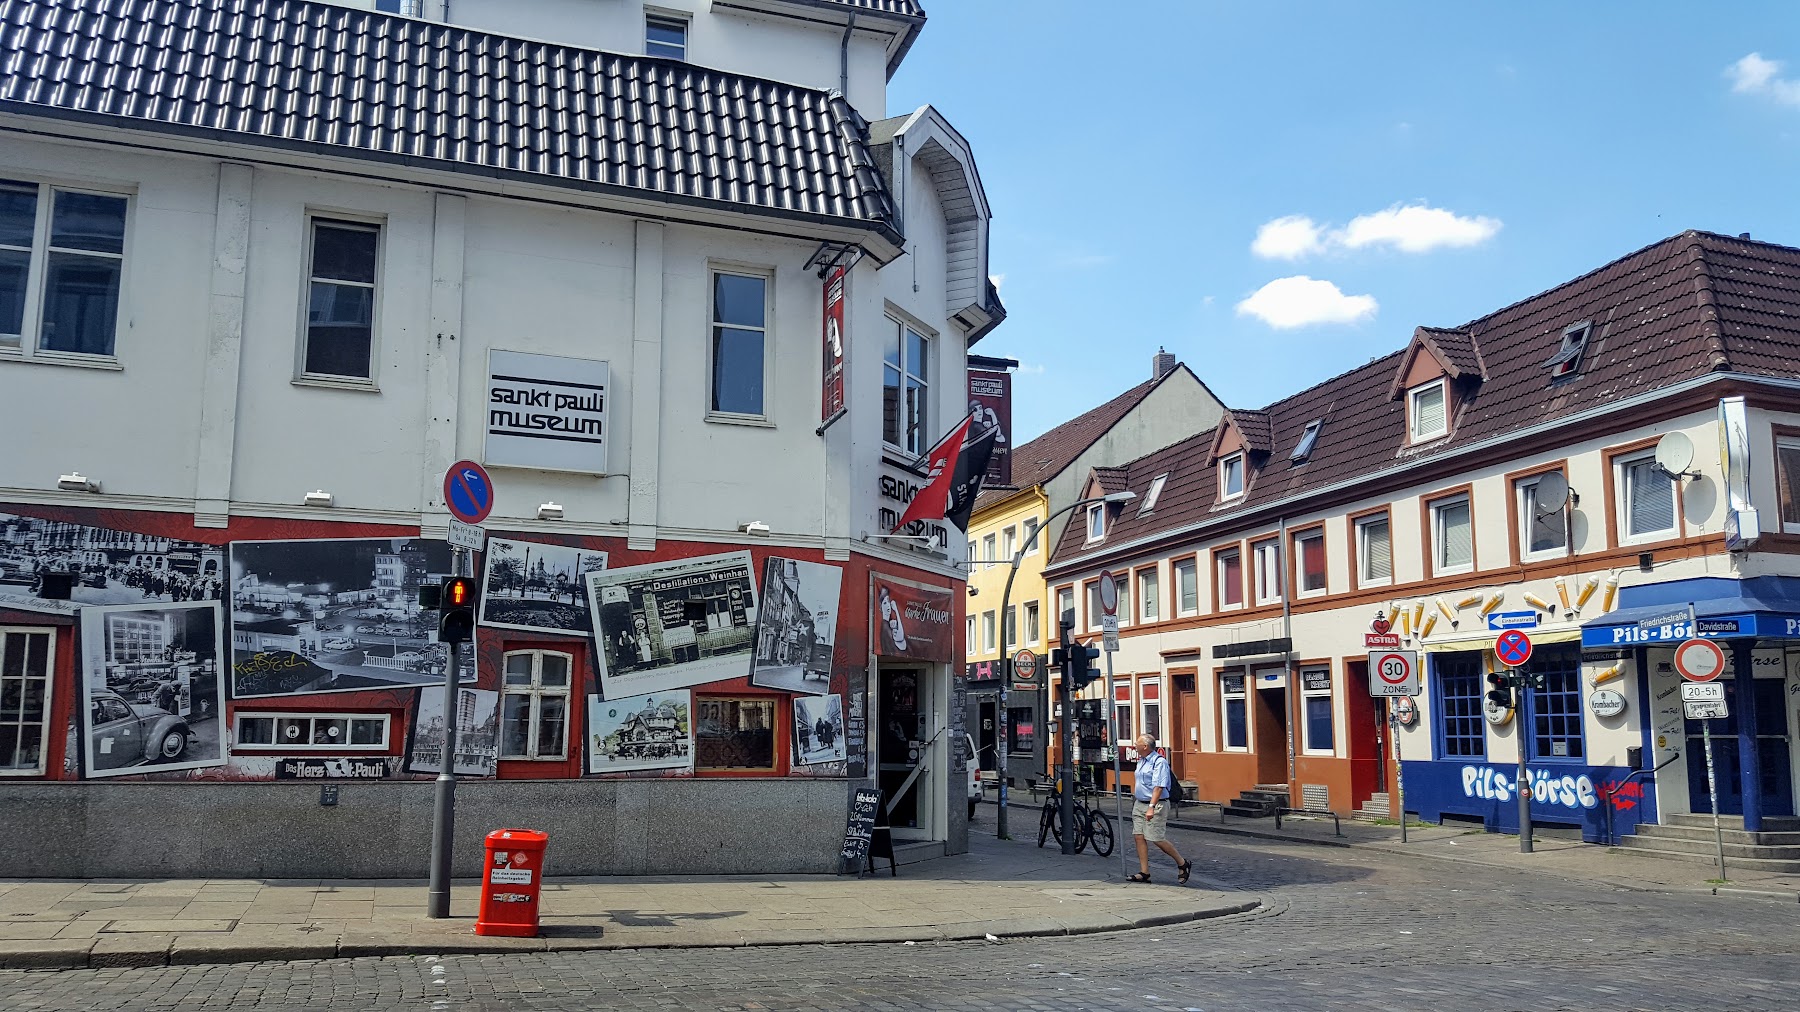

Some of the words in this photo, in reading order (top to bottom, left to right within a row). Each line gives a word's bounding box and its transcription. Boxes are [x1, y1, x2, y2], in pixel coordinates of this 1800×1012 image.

[971, 380, 989, 389] sankt
[989, 381, 1003, 389] pauli
[971, 387, 1003, 395] museum
[490, 387, 552, 408] sankt
[554, 392, 604, 413] pauli
[490, 409, 602, 435] museum
[880, 474, 920, 504] sankt
[653, 576, 704, 591] Destillation
[920, 600, 950, 625] Frauen
[1501, 616, 1535, 624] Einbahnstraße
[1640, 612, 1689, 628] Friedrichstraße
[1699, 622, 1737, 631] Davidstraße
[1367, 636, 1397, 644] ASTRA
[1384, 663, 1403, 676] 30
[1591, 698, 1621, 709] Krombacher
[285, 763, 297, 773] Das
[296, 761, 325, 778] Herz
